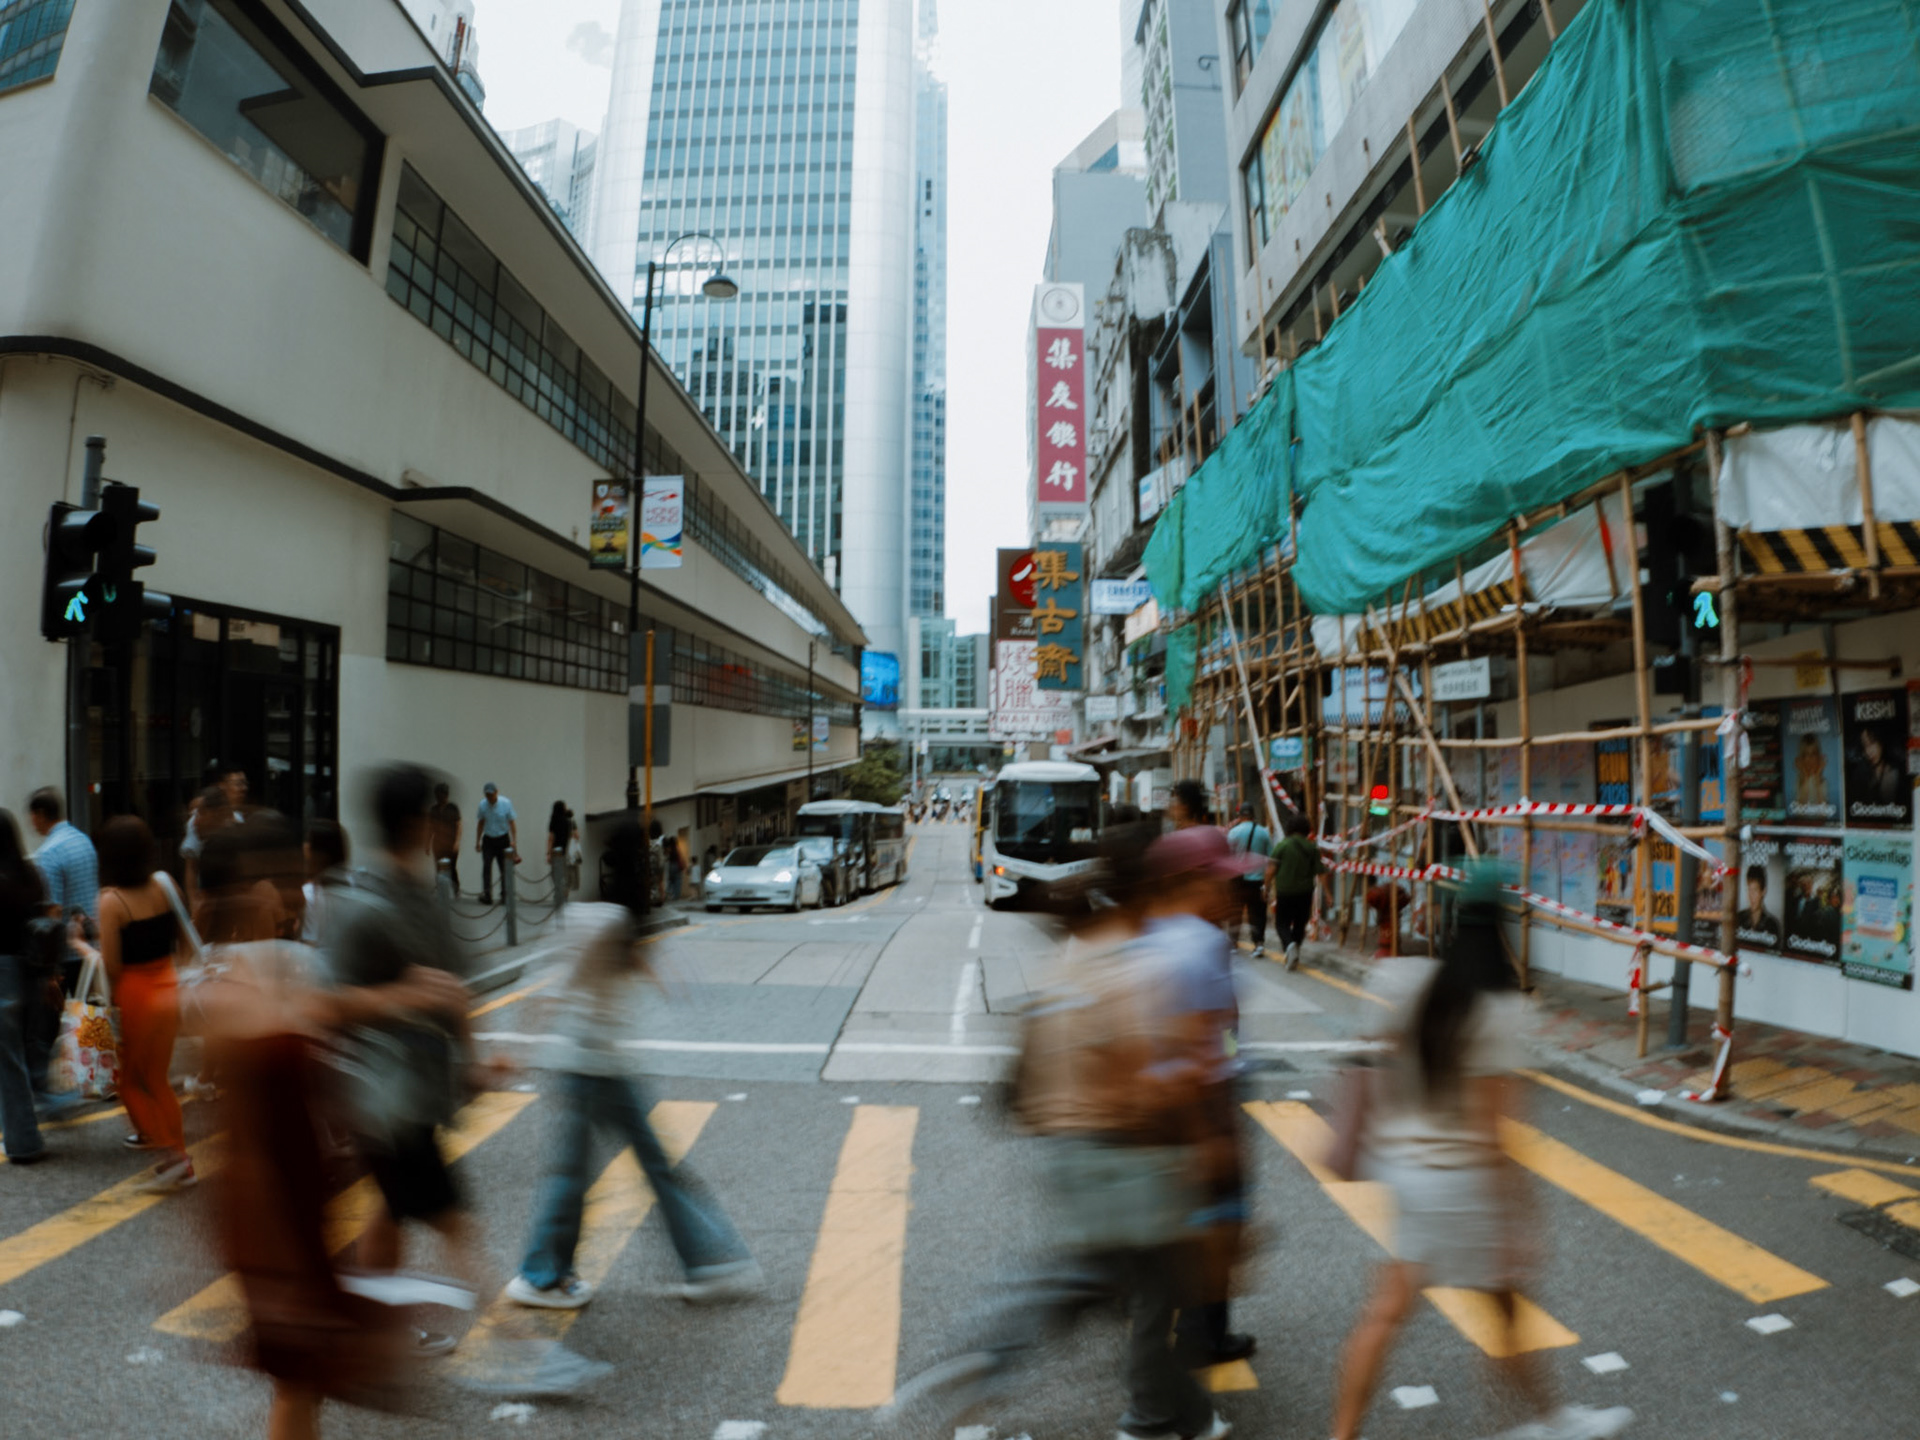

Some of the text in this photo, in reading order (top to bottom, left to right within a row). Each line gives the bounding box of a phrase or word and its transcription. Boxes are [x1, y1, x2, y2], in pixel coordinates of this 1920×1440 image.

[1044, 337, 1079, 491] 集友銀行
[646, 506, 679, 515] HONG
[646, 514, 679, 524] KONG
[1029, 550, 1080, 683] 集古齋
[1855, 699, 1896, 722] KESHI
[1788, 801, 1838, 818] Clockenflap
[1850, 801, 1907, 820] Clockenflap
[1846, 845, 1912, 869] Clockenflap
[1787, 933, 1837, 957] Clockenflap
